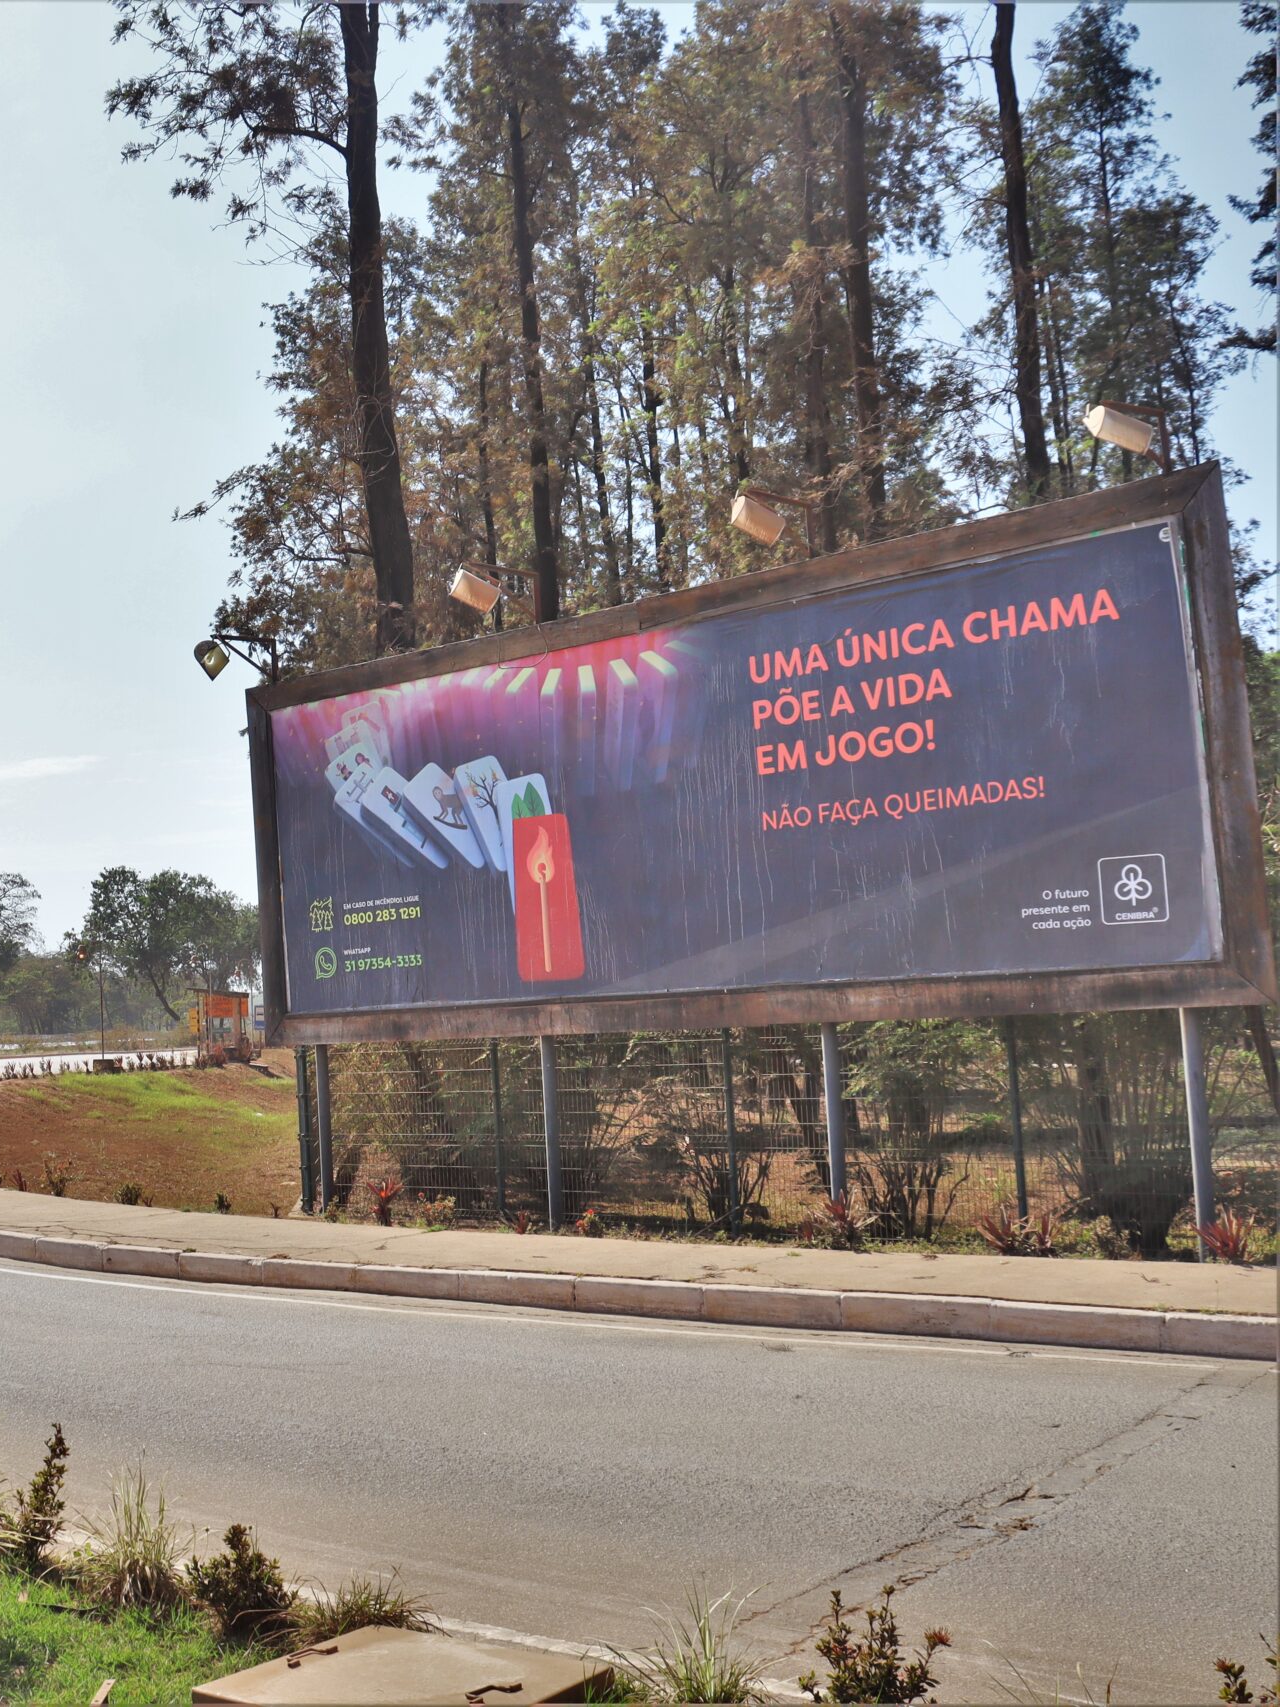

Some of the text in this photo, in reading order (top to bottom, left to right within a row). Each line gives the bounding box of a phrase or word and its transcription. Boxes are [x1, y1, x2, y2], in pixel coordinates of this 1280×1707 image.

[748, 588, 1120, 684] UMA ÚNICA CHAMA
[752, 668, 952, 730] PÕE A VIDA
[756, 718, 936, 775] EM JOGO!
[761, 776, 1046, 831] NÃO FAÇA QUEIMADAS!
[1042, 888, 1090, 900] O futuro
[344, 906, 420, 925] 0800 283 1291
[1021, 903, 1091, 918] presente em
[1032, 917, 1092, 930] cada ação
[344, 960, 356, 972] 31
